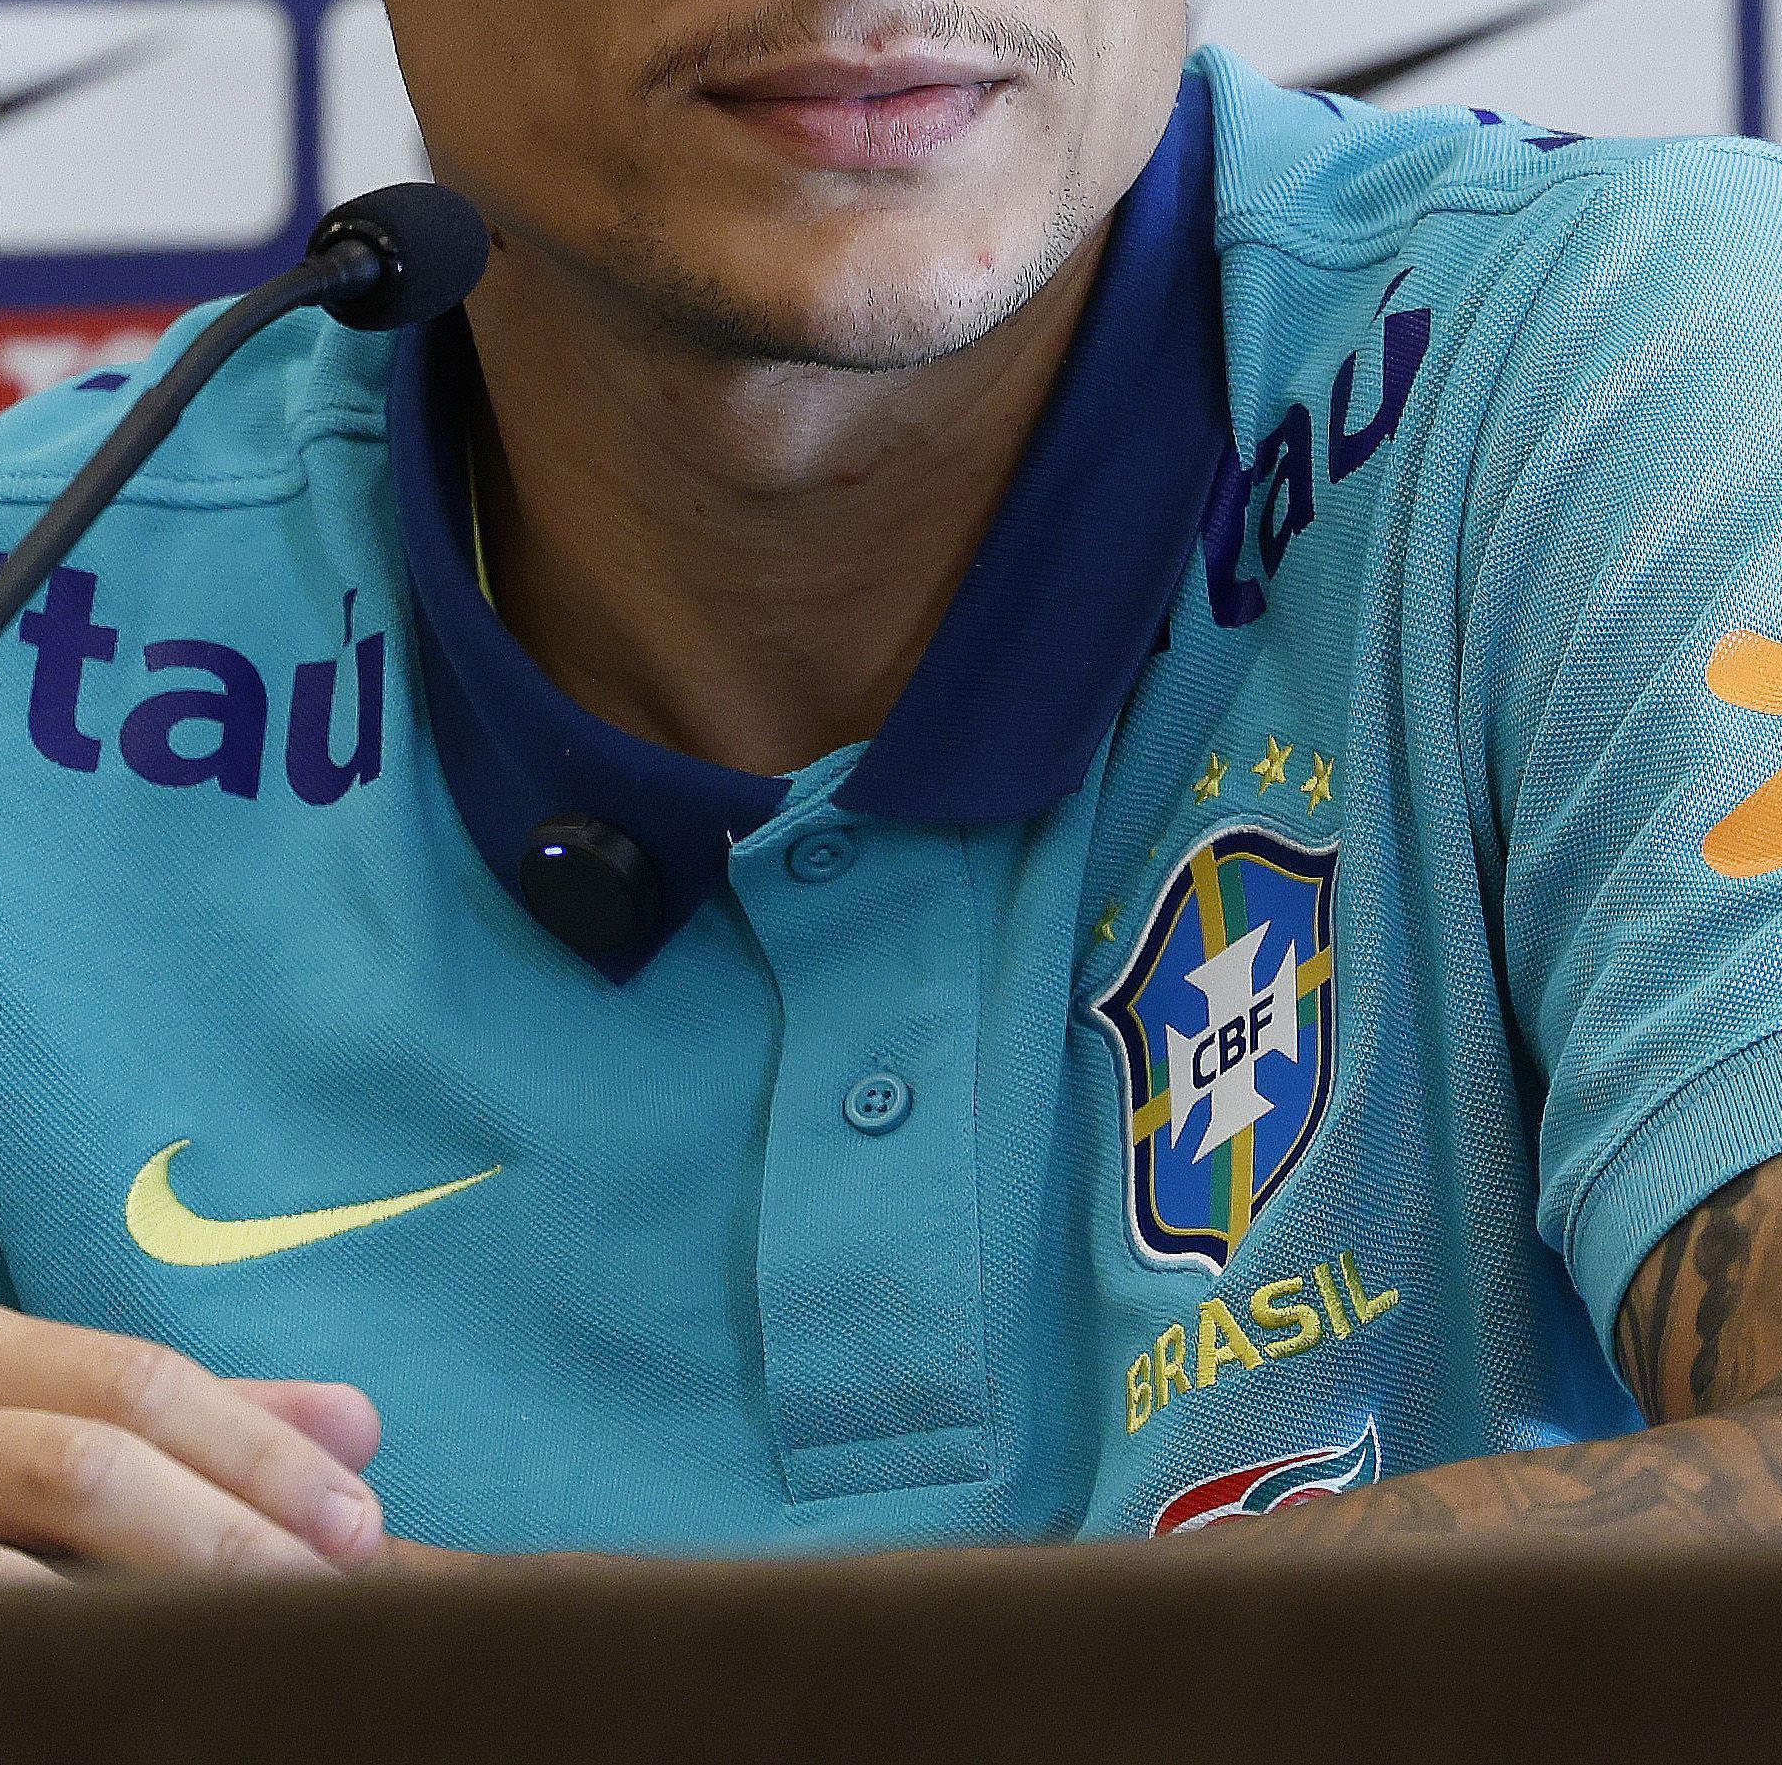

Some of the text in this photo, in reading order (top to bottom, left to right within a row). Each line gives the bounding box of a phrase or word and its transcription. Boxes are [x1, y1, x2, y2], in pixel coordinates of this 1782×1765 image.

[1163, 266, 1431, 644] taú
[1191, 992, 1275, 1090] CBF
[1126, 1250, 1399, 1434] BRASIL
